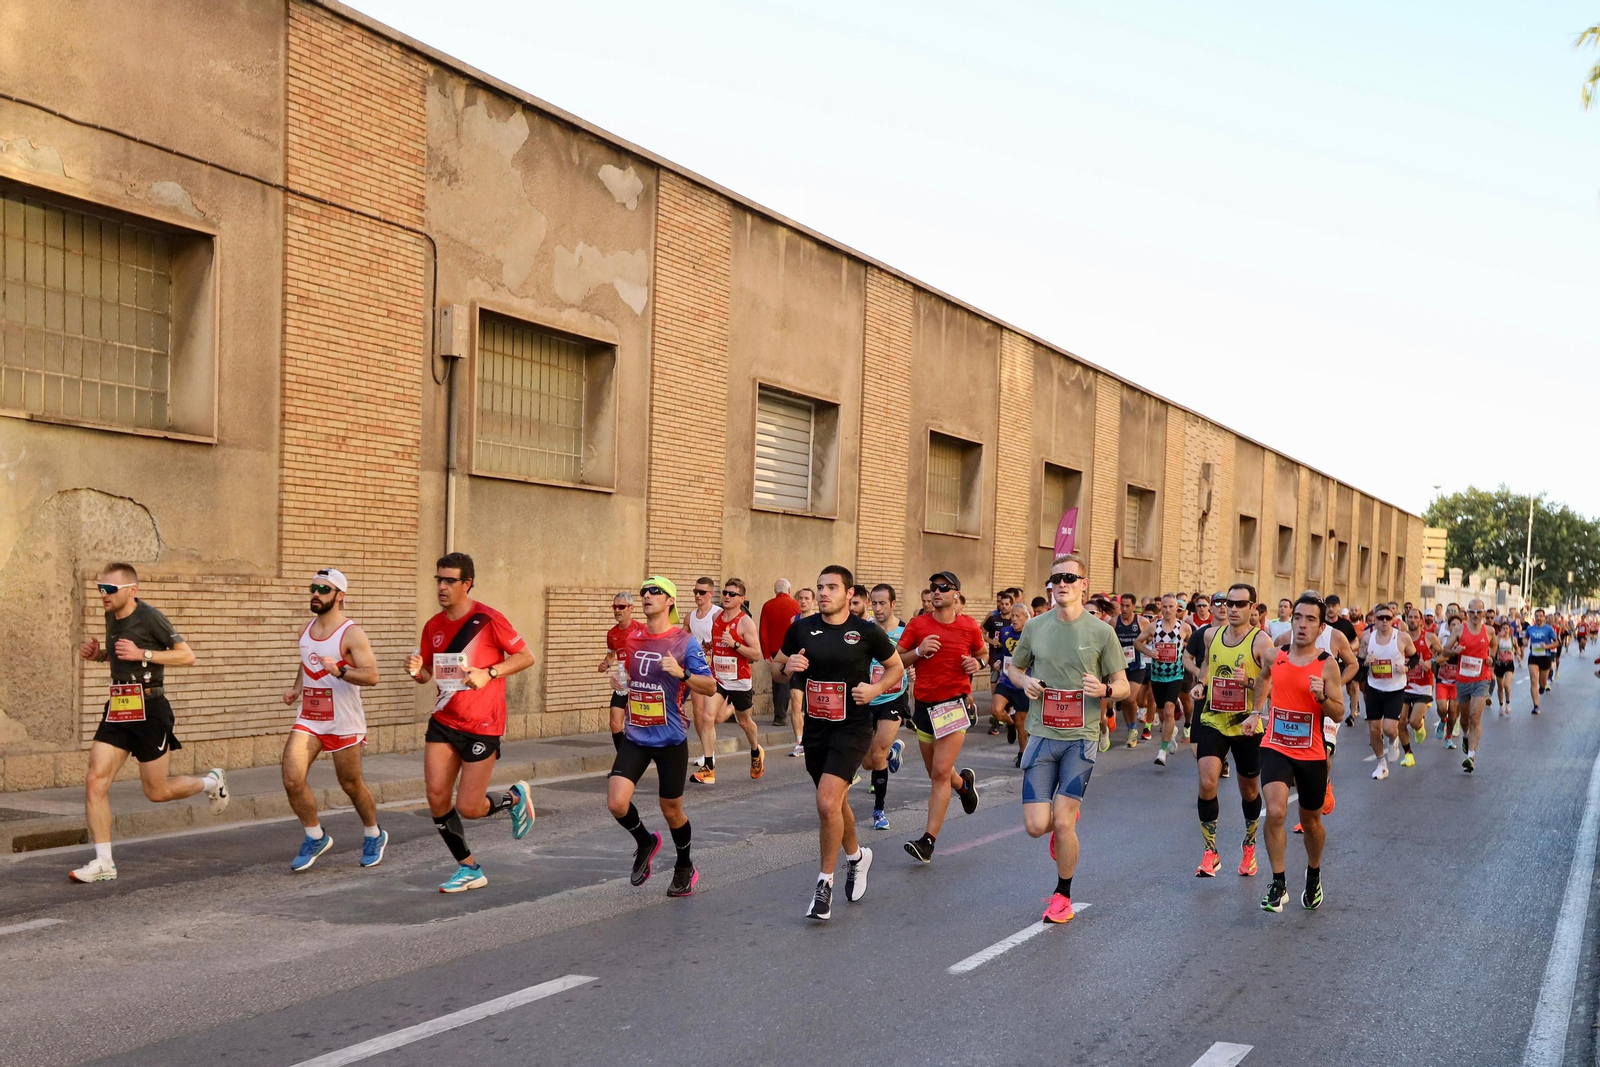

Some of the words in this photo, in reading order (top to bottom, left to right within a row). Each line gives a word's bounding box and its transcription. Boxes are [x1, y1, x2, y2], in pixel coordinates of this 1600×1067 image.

[816, 695, 830, 703] 473
[1055, 703, 1069, 711] 707
[1282, 722, 1299, 731] 1643
